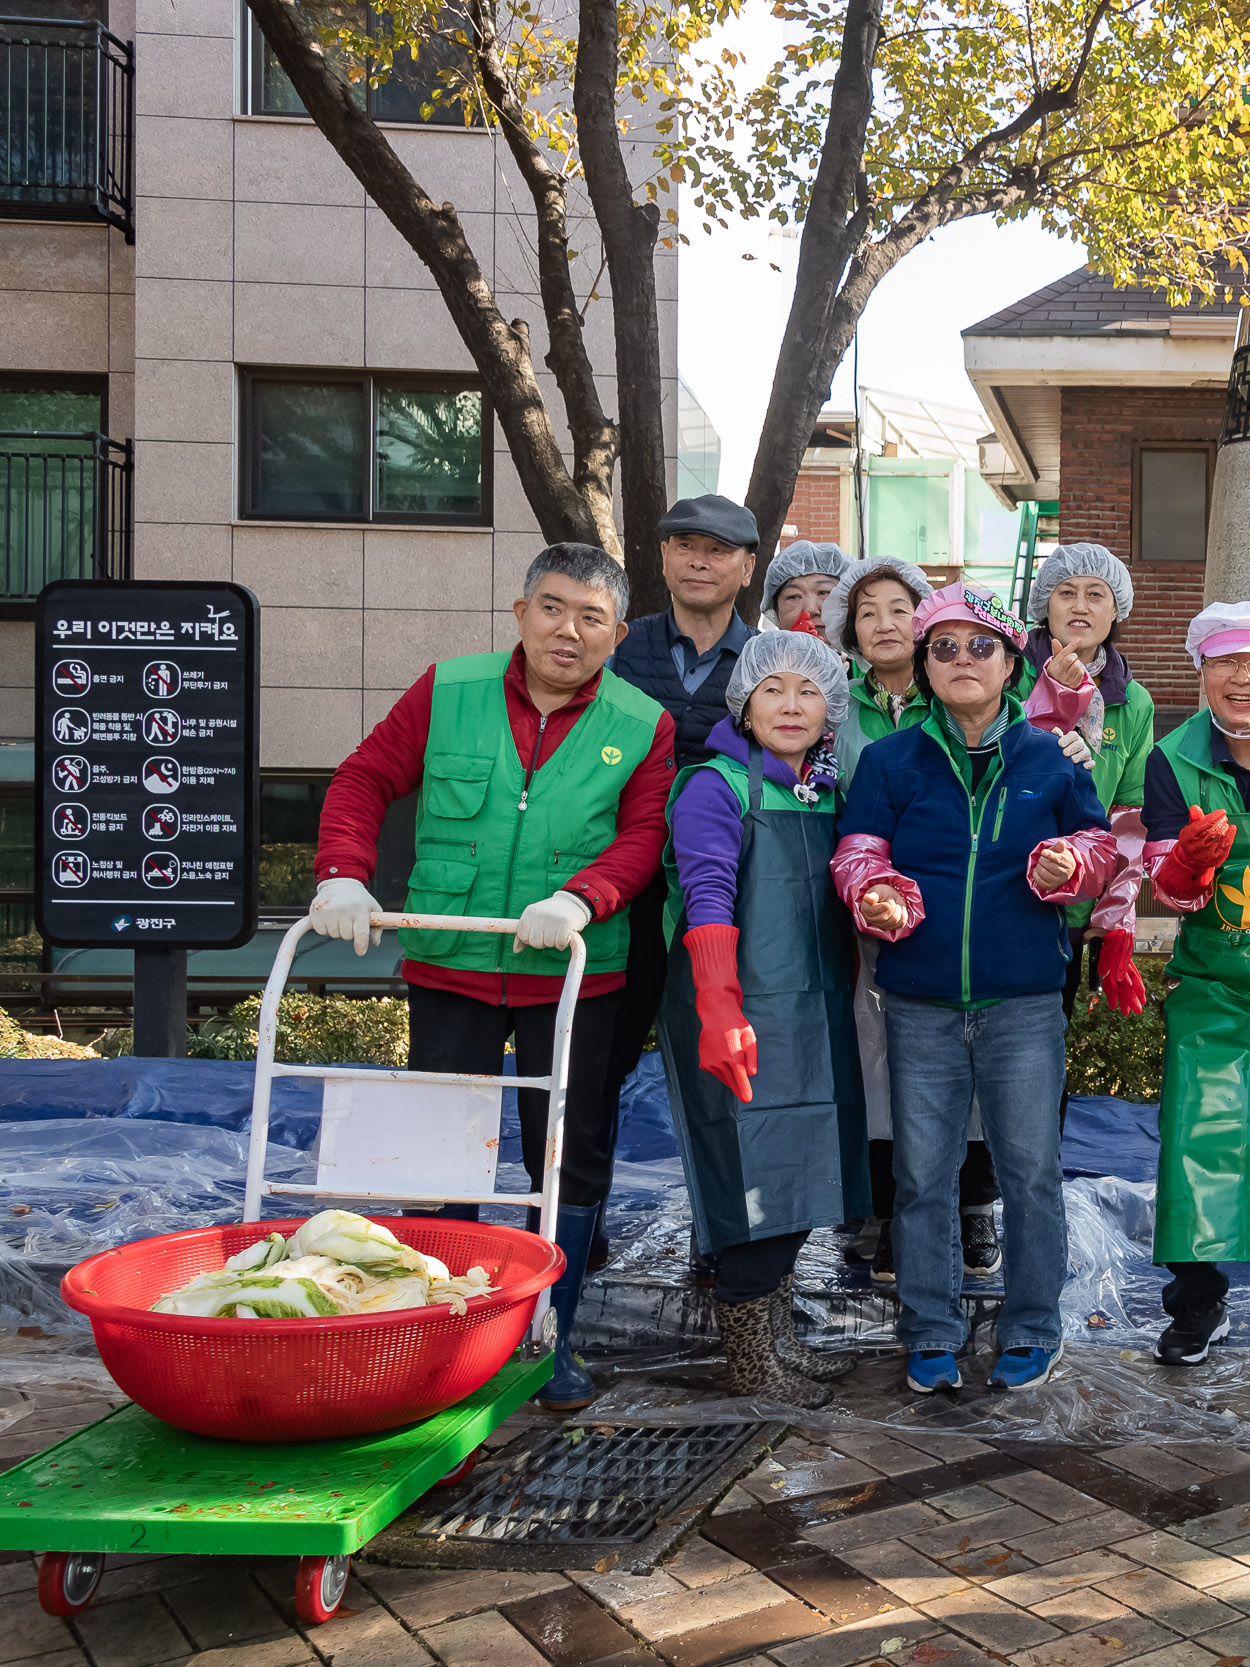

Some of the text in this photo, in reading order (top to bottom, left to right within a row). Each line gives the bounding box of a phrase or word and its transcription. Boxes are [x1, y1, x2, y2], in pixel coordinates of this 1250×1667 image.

[964, 590, 991, 612] 광진구
[53, 614, 238, 640] 우리 이것만은 지켜요
[109, 675, 123, 683] 금지
[183, 671, 204, 679] 쓰레기
[183, 681, 211, 689] 무단투기
[122, 713, 135, 721] 동반
[108, 723, 121, 731] 착용
[199, 719, 206, 727] 및
[208, 719, 236, 727] 공원시설
[123, 733, 137, 741] 지참
[183, 729, 213, 737] 훼손 금지
[182, 776, 196, 784] 이용
[1018, 791, 1042, 800] SMU
[92, 813, 127, 821] 전동킥보드
[92, 823, 123, 831] 이용 금지
[182, 824, 203, 832] 자전거
[136, 919, 176, 929] 광진구
[129, 1523, 150, 1548] 2
